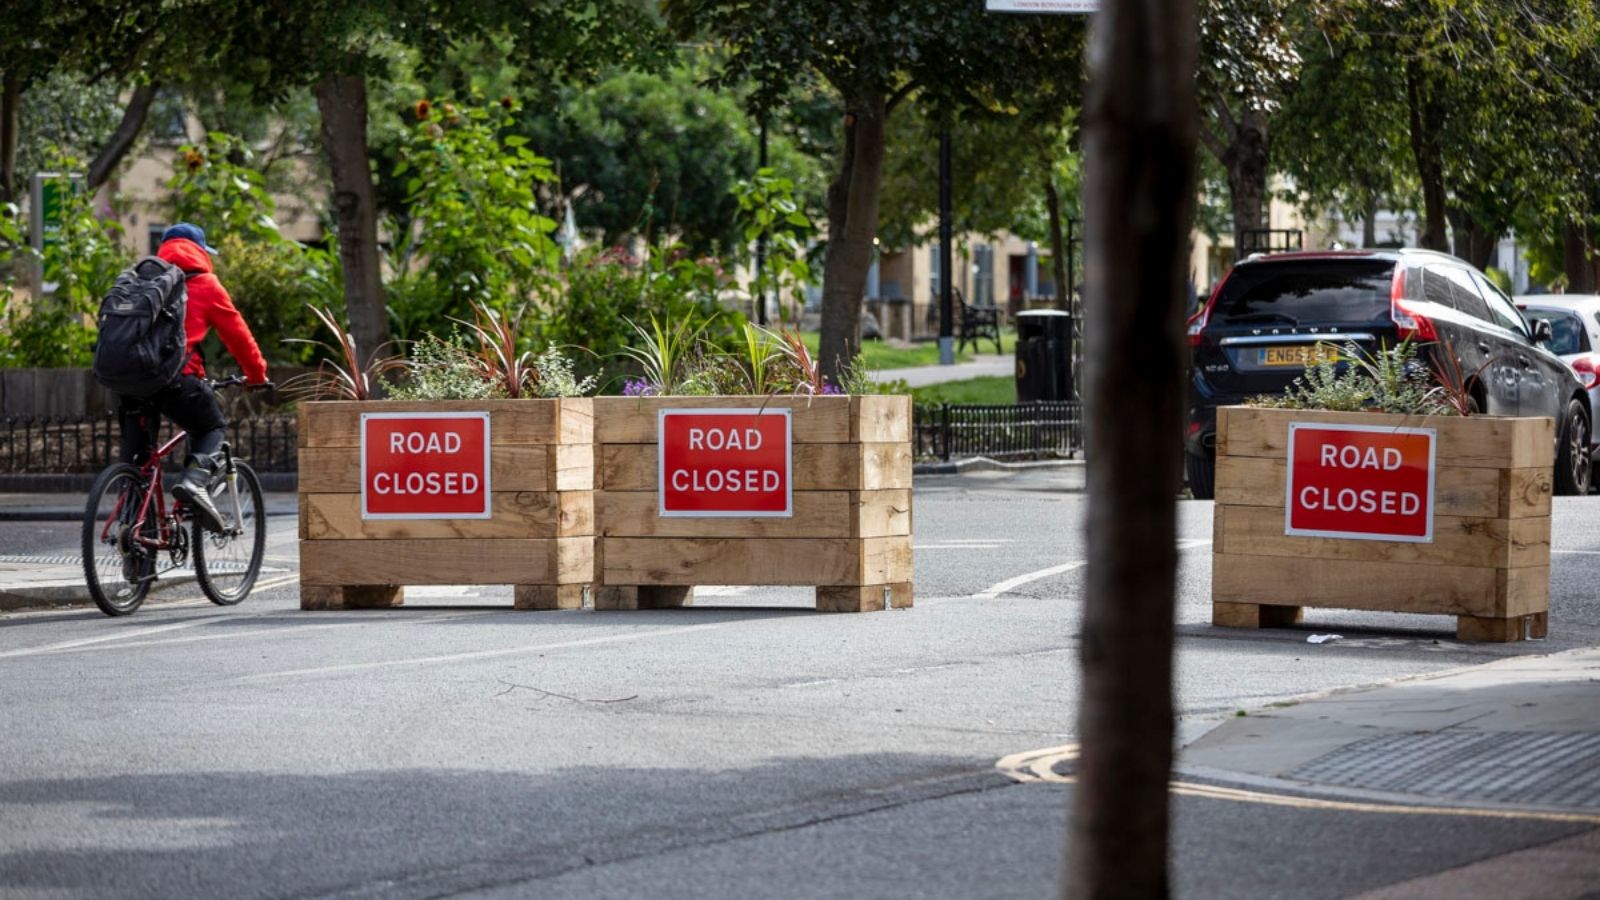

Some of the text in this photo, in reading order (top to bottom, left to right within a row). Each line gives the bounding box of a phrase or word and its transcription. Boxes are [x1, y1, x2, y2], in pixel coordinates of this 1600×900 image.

[1252, 327, 1338, 335] VOLVO
[390, 432, 462, 454] ROAD
[689, 428, 762, 450] ROAD
[1321, 444, 1402, 471] ROAD
[373, 472, 479, 494] CLOSED
[672, 469, 780, 492] CLOSED
[1300, 486, 1420, 515] CLOSED
